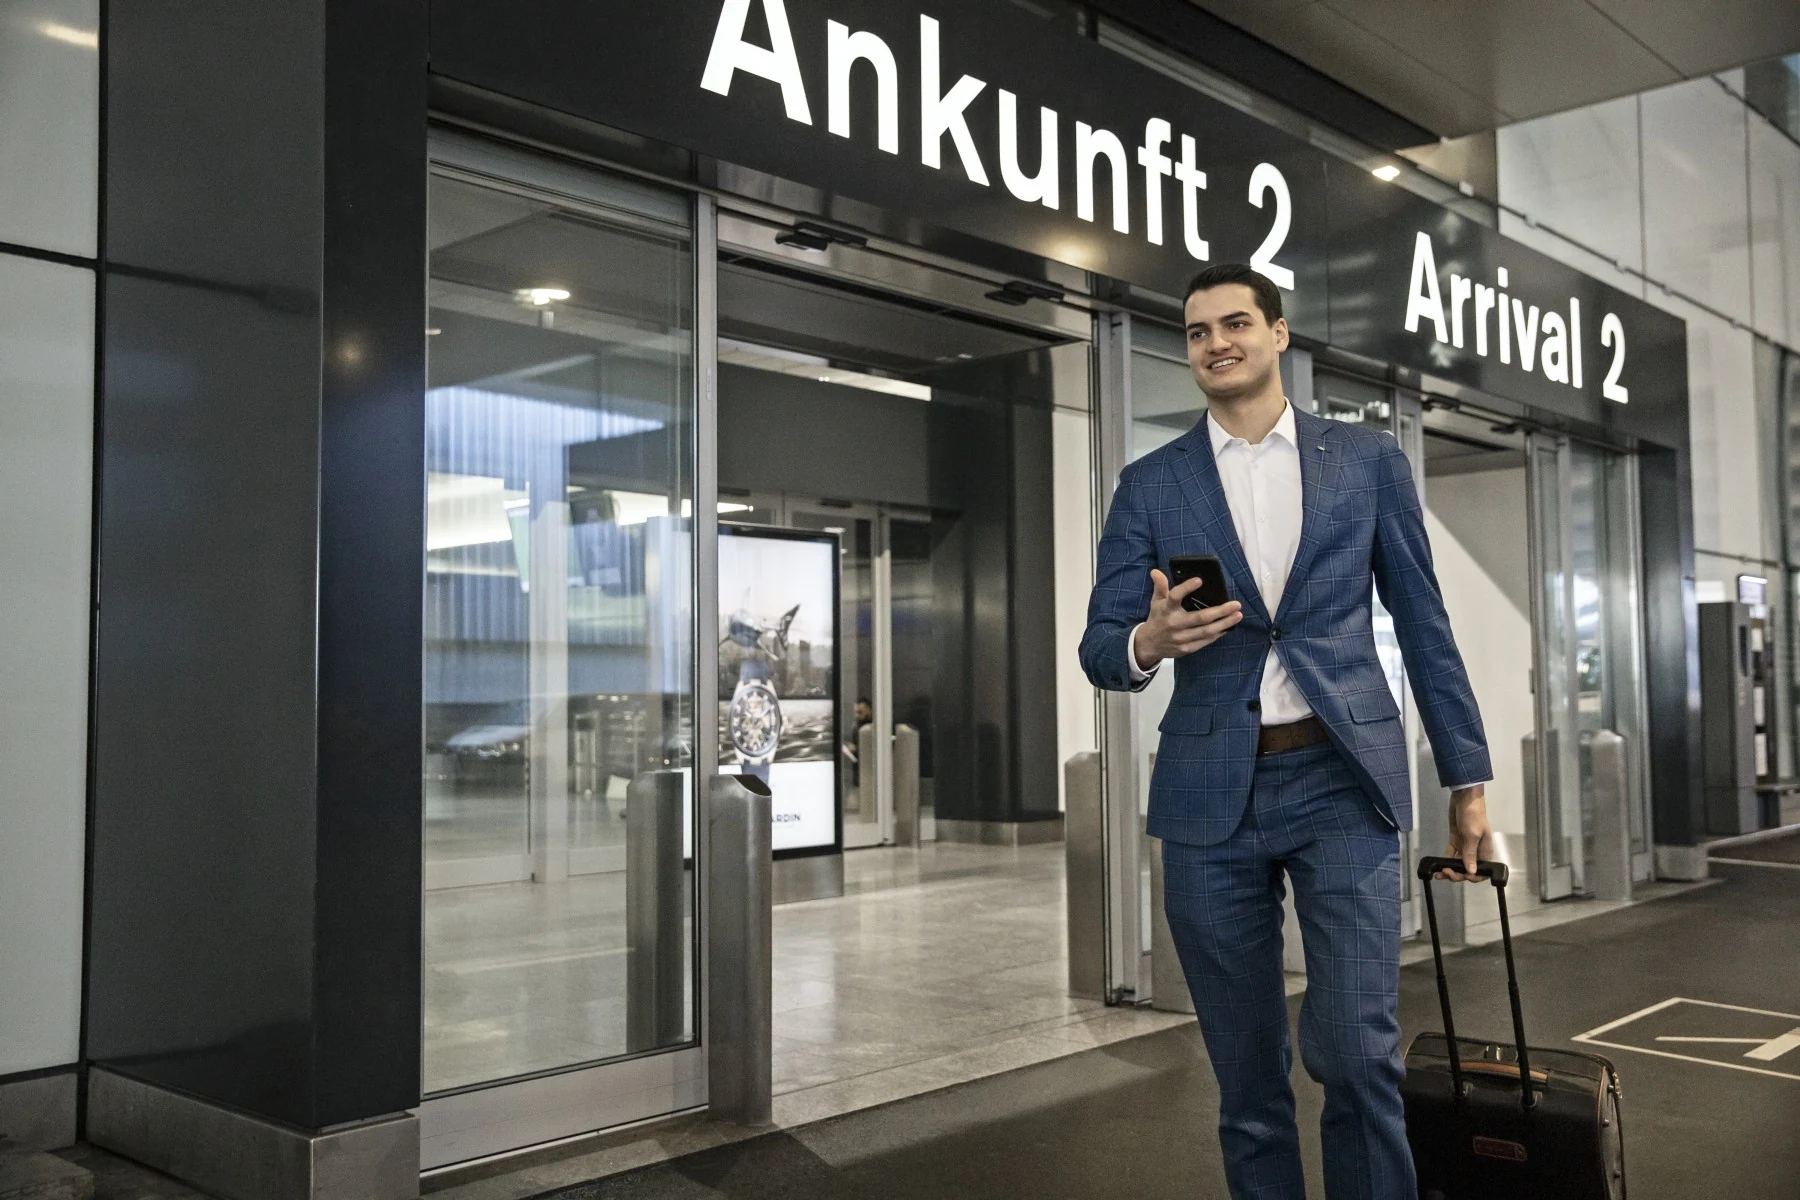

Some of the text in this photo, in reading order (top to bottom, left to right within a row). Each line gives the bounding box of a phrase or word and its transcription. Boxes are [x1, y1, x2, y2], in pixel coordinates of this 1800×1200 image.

[700, 0, 1295, 291] Ankunft 2
[1404, 231, 1629, 404] Arrival 2
